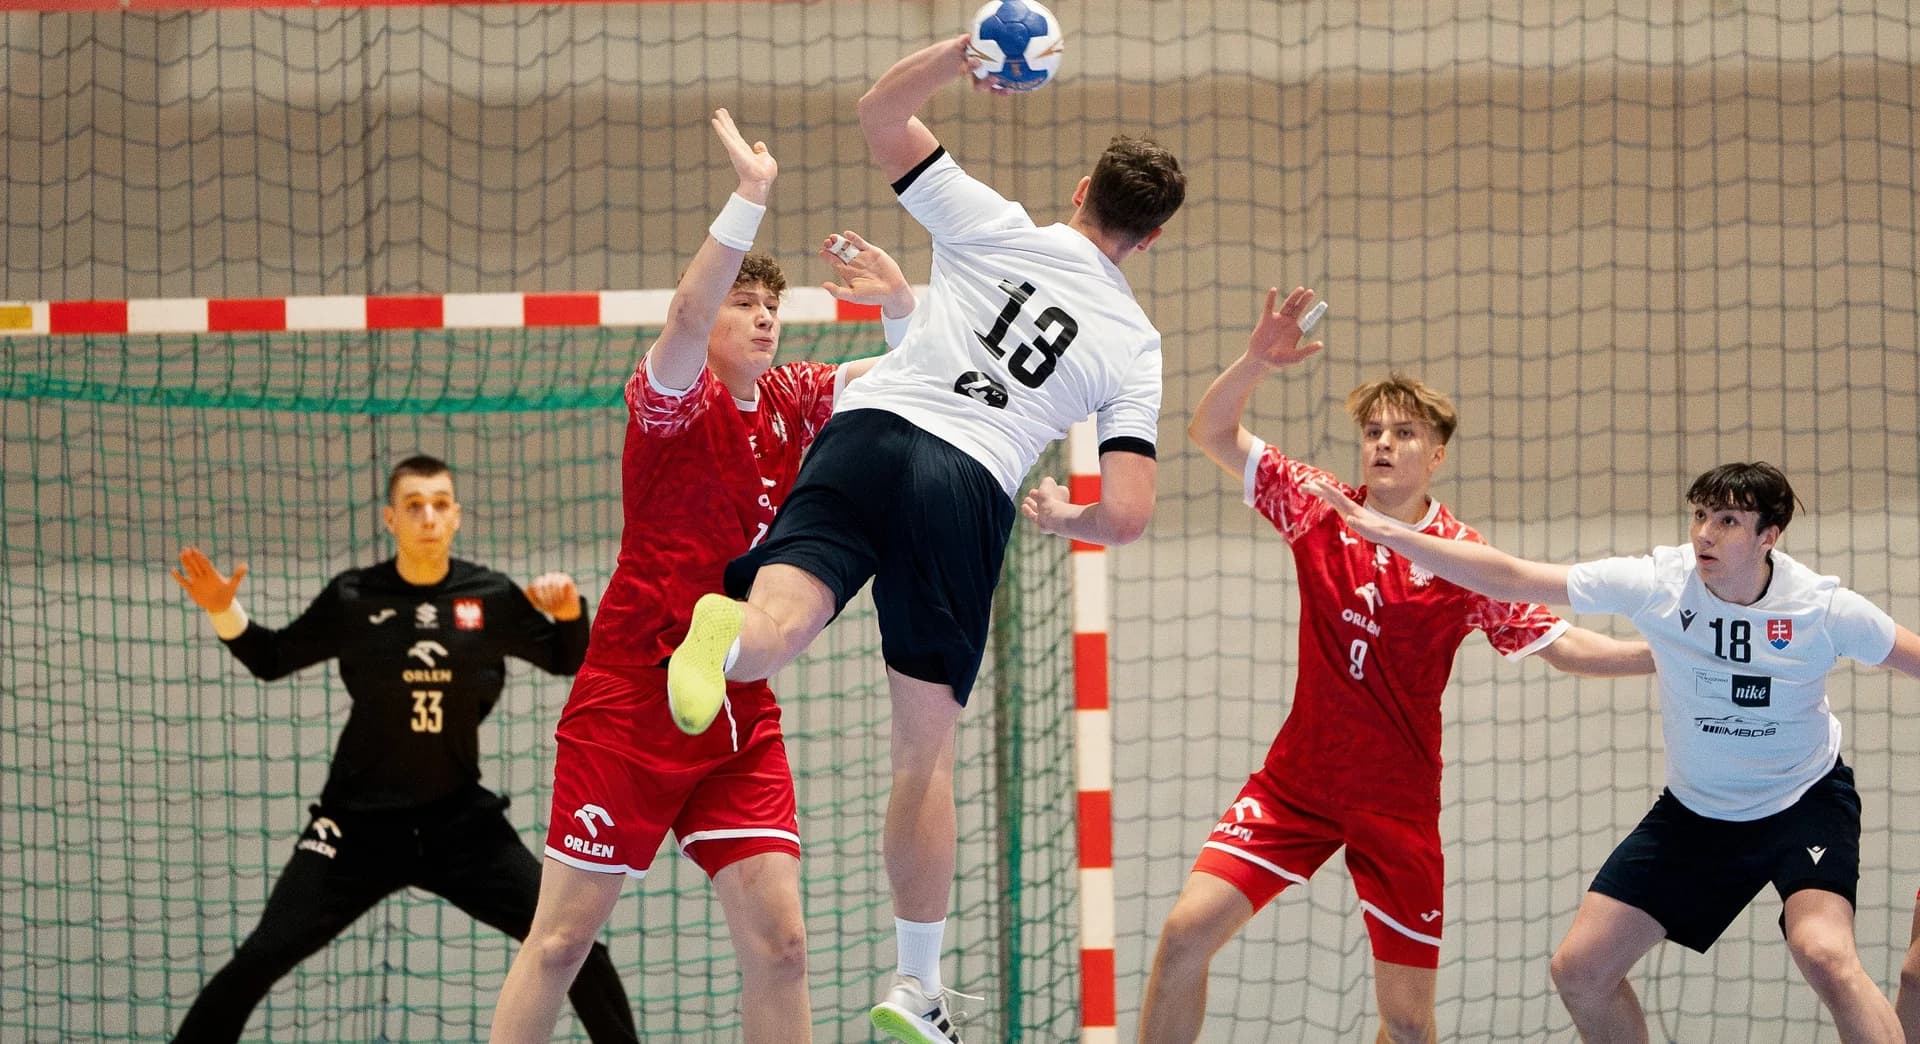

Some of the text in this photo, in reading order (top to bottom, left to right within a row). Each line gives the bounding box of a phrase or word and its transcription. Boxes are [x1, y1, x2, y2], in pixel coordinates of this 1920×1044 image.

[973, 279, 1079, 389] 13
[1349, 639, 1368, 680] 9
[1709, 618, 1751, 663] 18
[403, 669, 452, 682] ORLEN
[411, 691, 443, 733] 33
[563, 834, 615, 858] ORLEN
